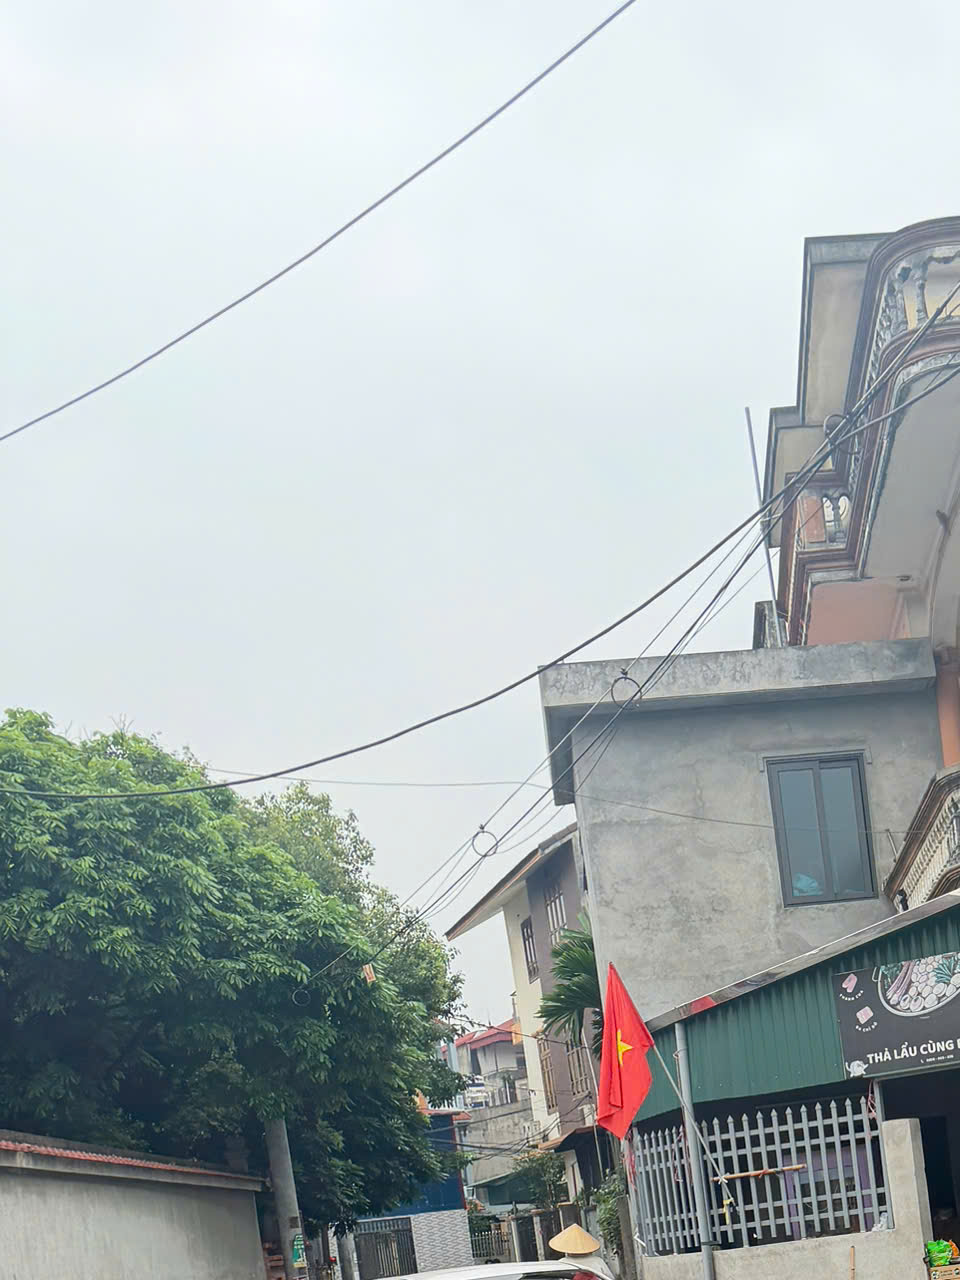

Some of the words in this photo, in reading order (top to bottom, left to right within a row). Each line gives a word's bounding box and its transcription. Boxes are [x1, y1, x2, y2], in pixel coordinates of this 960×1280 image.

[867, 1048, 892, 1065] THẢ
[893, 1041, 918, 1060] LẨU
[920, 1039, 955, 1055] CÙNG
